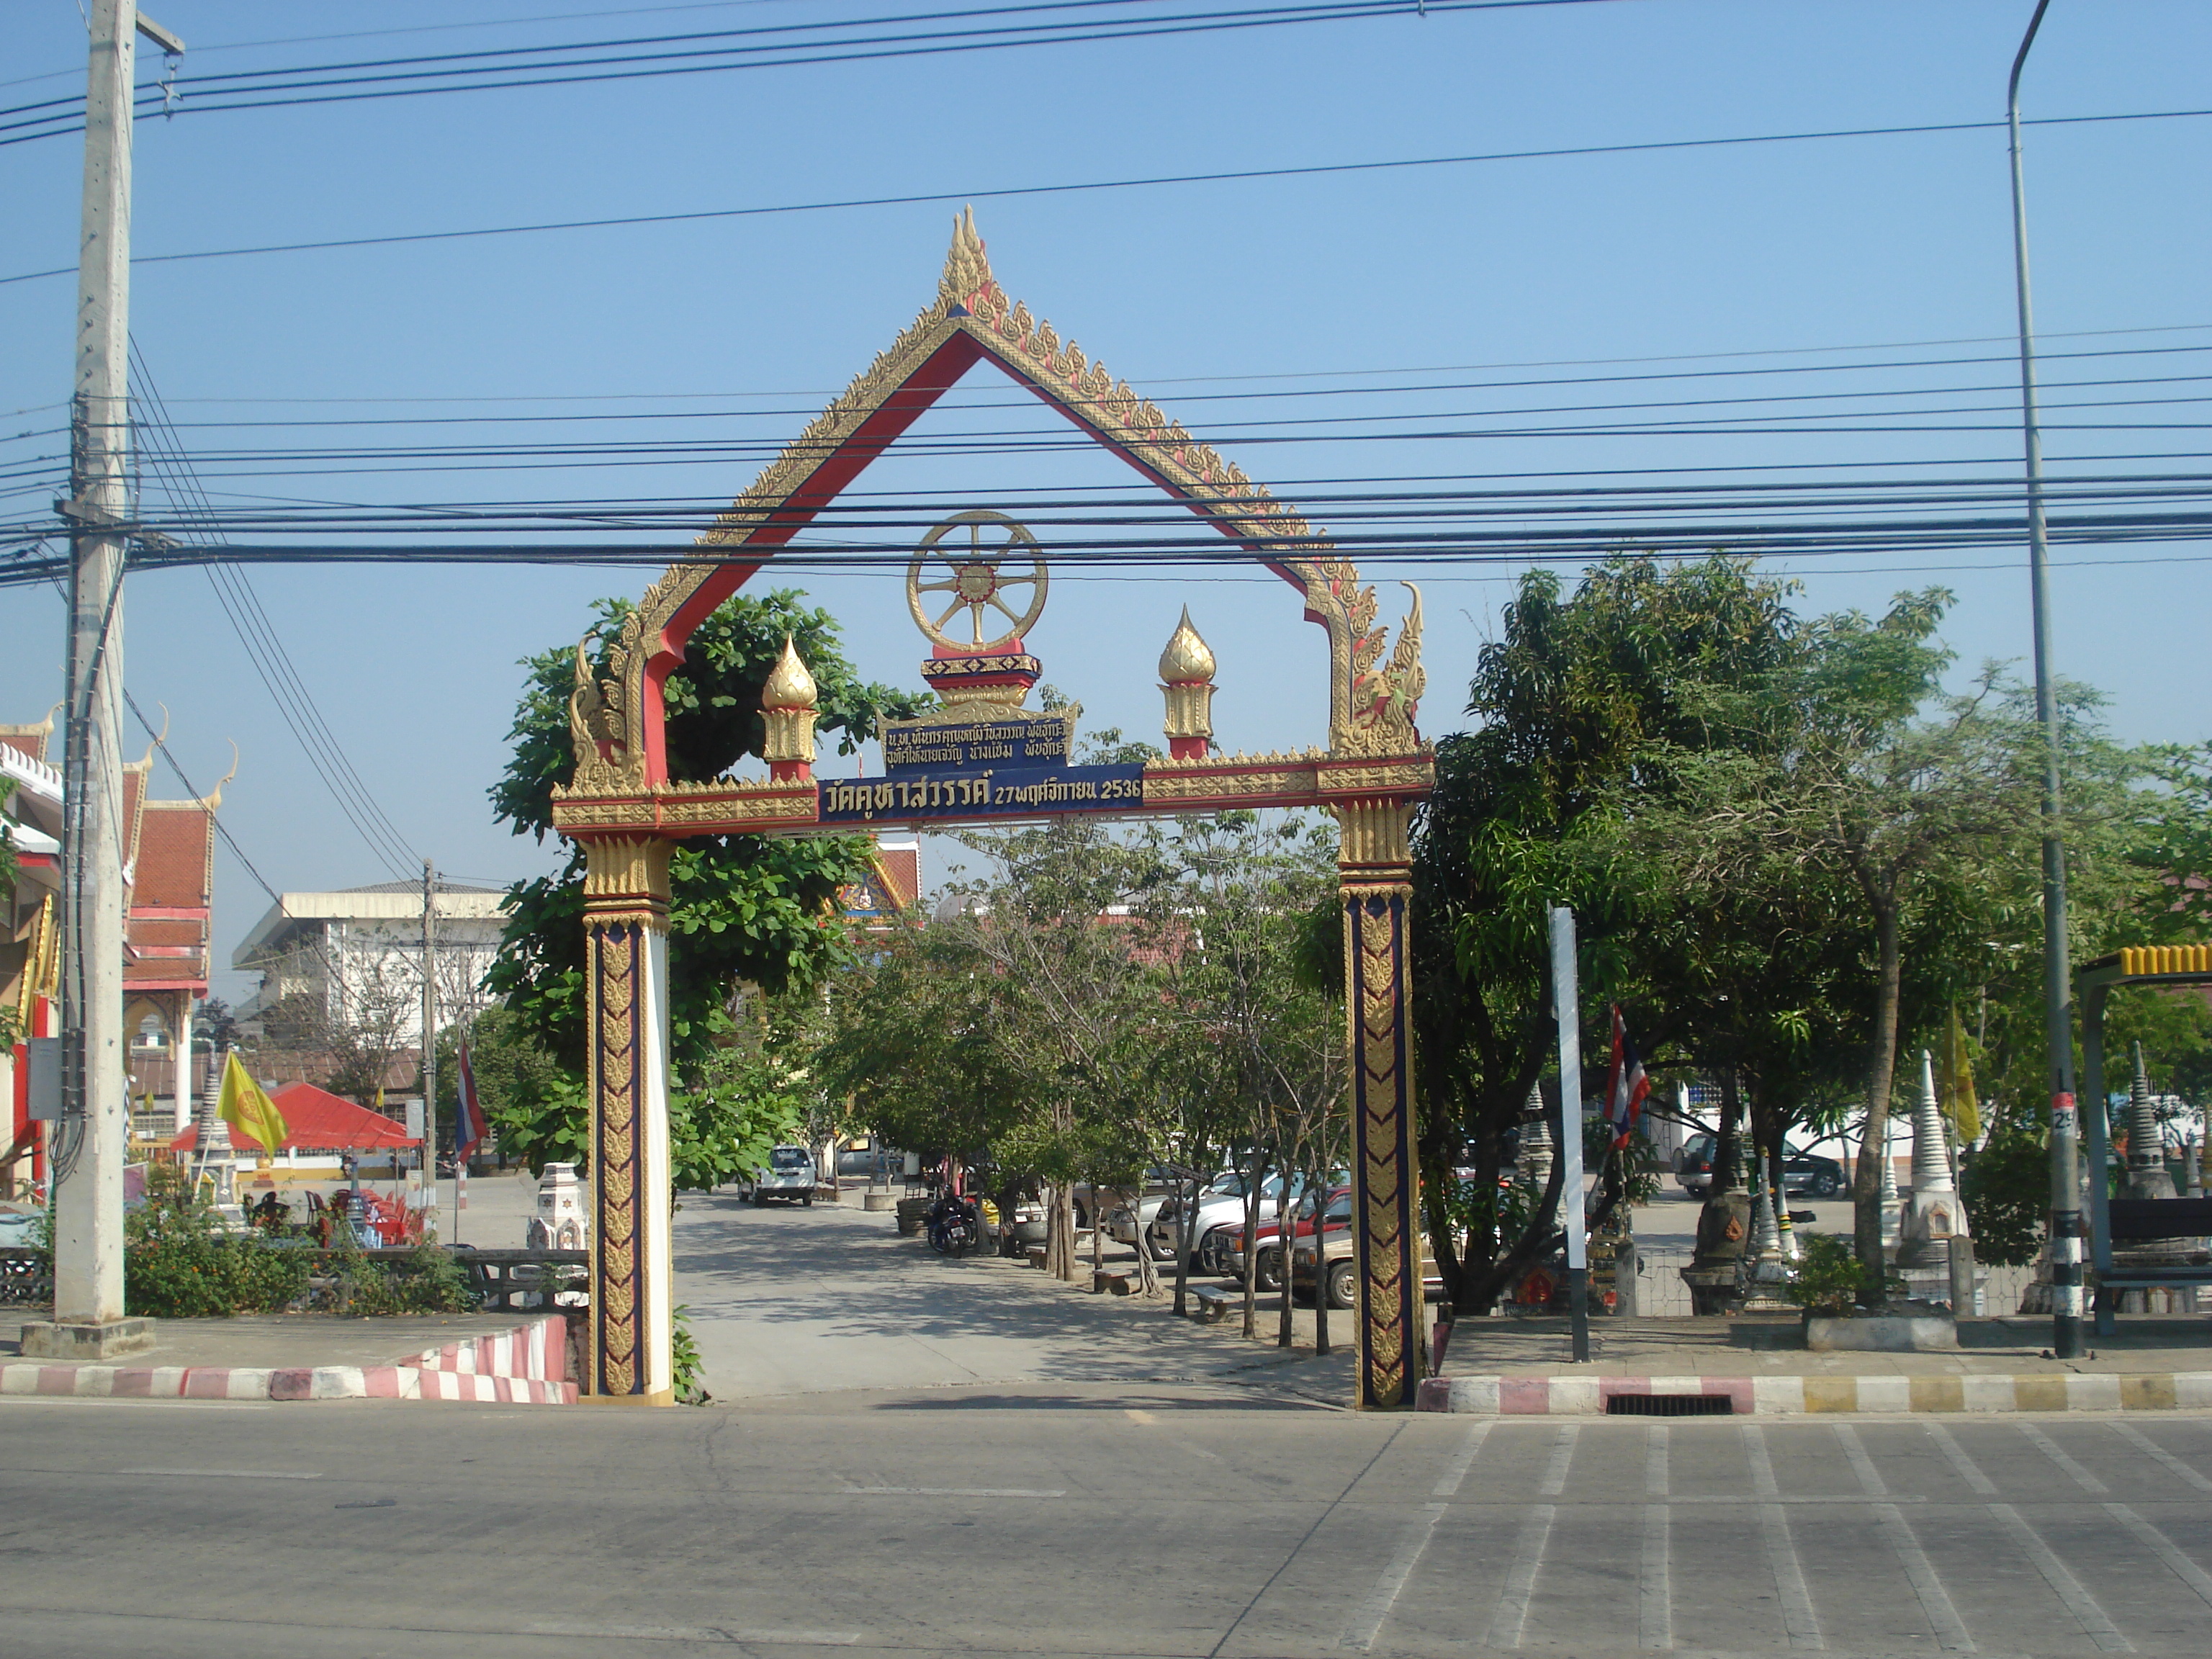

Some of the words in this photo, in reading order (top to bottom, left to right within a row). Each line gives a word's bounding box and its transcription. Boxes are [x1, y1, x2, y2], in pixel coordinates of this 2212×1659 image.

[825, 769, 993, 819] วัดคูหาสวรรค์
[1100, 779, 1141, 799] 2536
